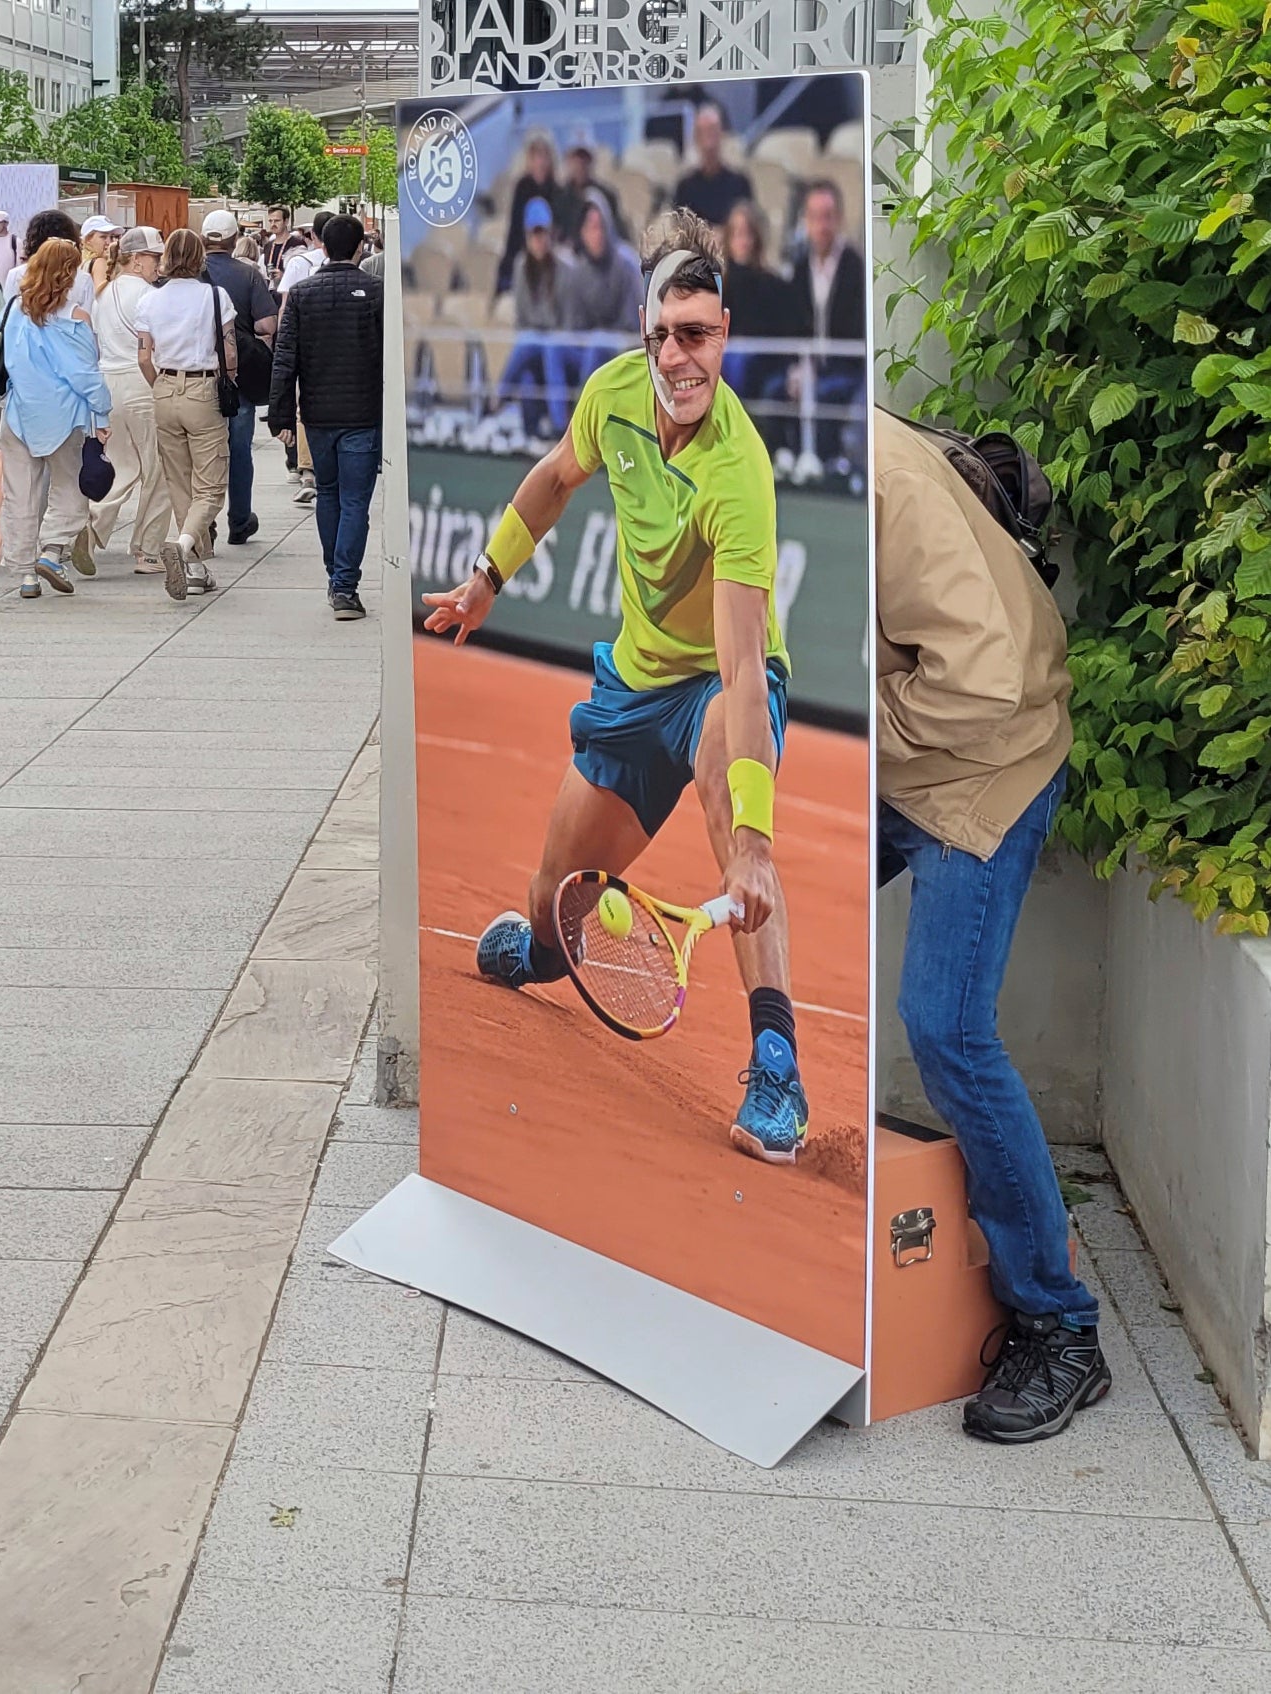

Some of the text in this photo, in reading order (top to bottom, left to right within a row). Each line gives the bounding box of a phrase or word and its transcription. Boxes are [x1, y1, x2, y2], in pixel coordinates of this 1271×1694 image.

[407, 115, 474, 181] ROLAND GARROS
[419, 197, 465, 219] PARIS
